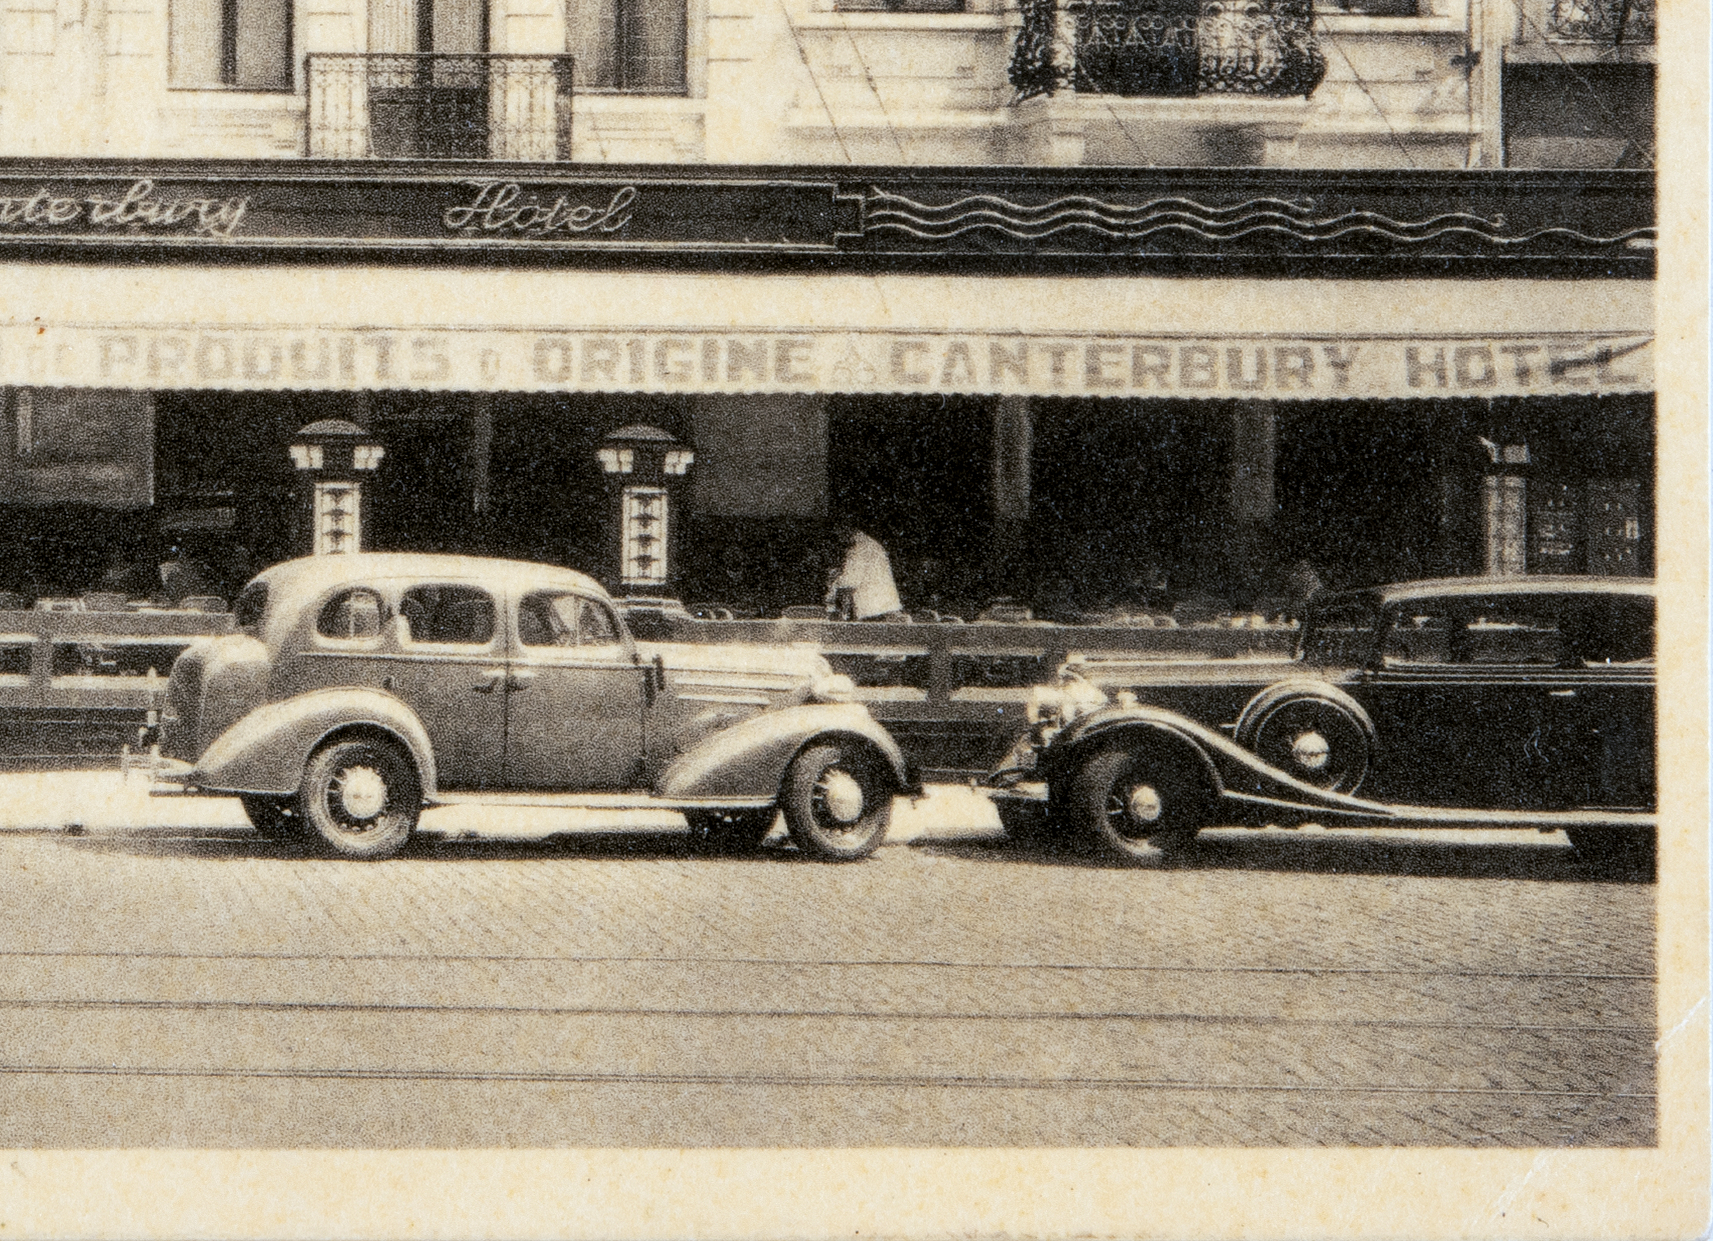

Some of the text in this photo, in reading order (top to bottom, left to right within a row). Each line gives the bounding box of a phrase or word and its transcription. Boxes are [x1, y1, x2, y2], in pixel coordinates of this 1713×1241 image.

[99, 333, 450, 382] PRODUITS
[532, 337, 821, 387] ORIGINE
[889, 340, 1364, 392] CANTERBURY
[1405, 342, 1639, 388] HOTEL
